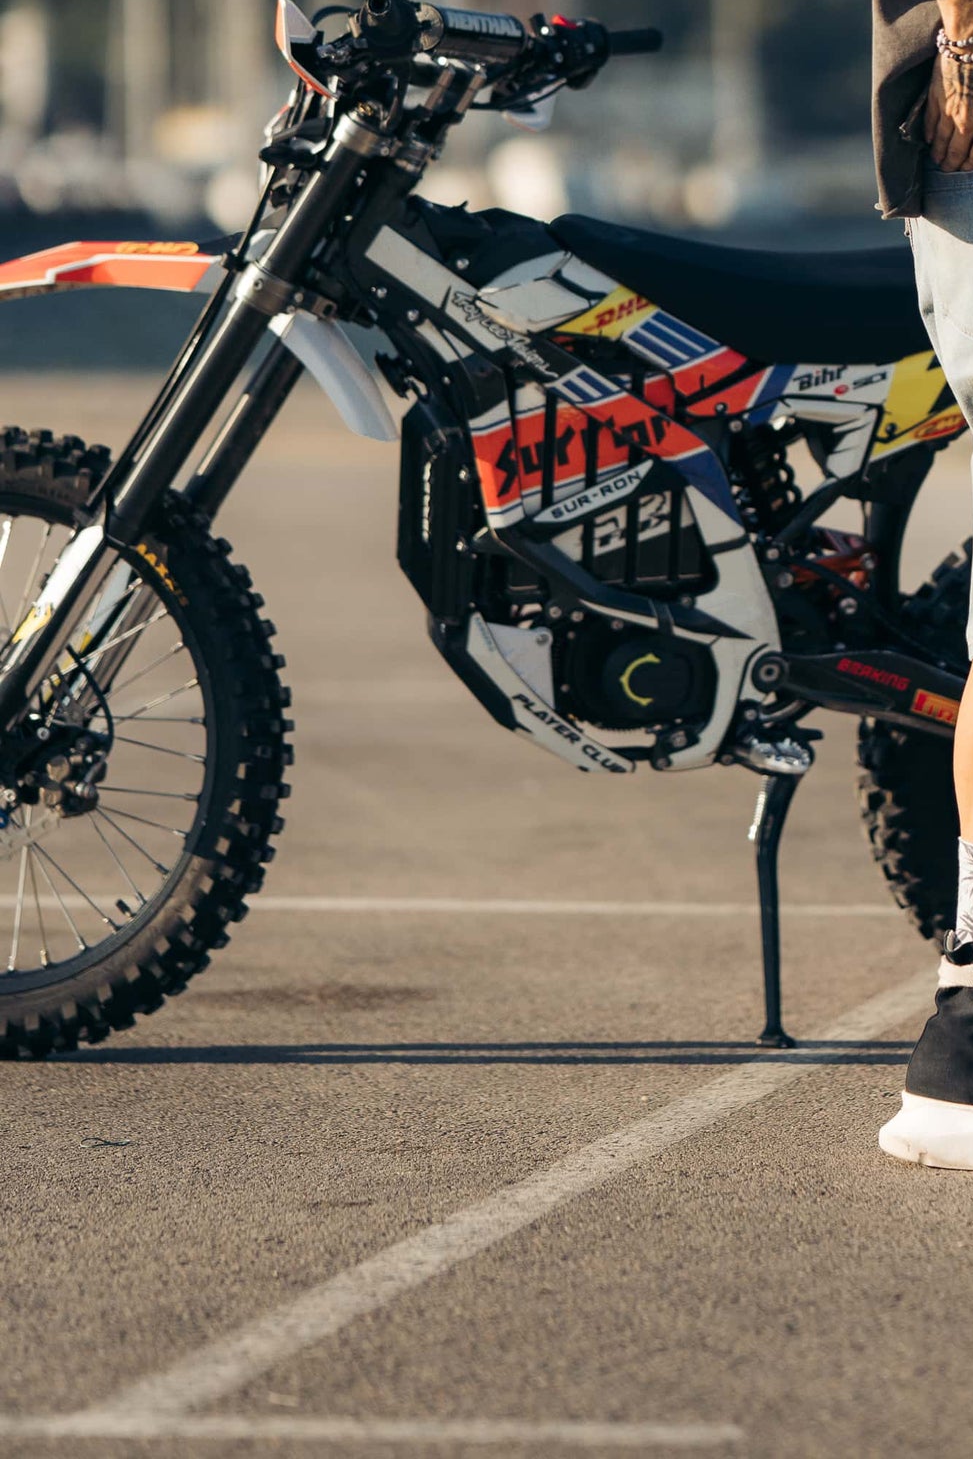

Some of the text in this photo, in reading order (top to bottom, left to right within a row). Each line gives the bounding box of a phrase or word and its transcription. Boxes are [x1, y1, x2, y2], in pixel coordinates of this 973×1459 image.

[447, 10, 522, 38] RENTHAL
[594, 295, 650, 329] DHL
[551, 470, 642, 519] SUR-RON
[836, 657, 912, 692] BRAKING
[512, 693, 581, 744] PLAYER
